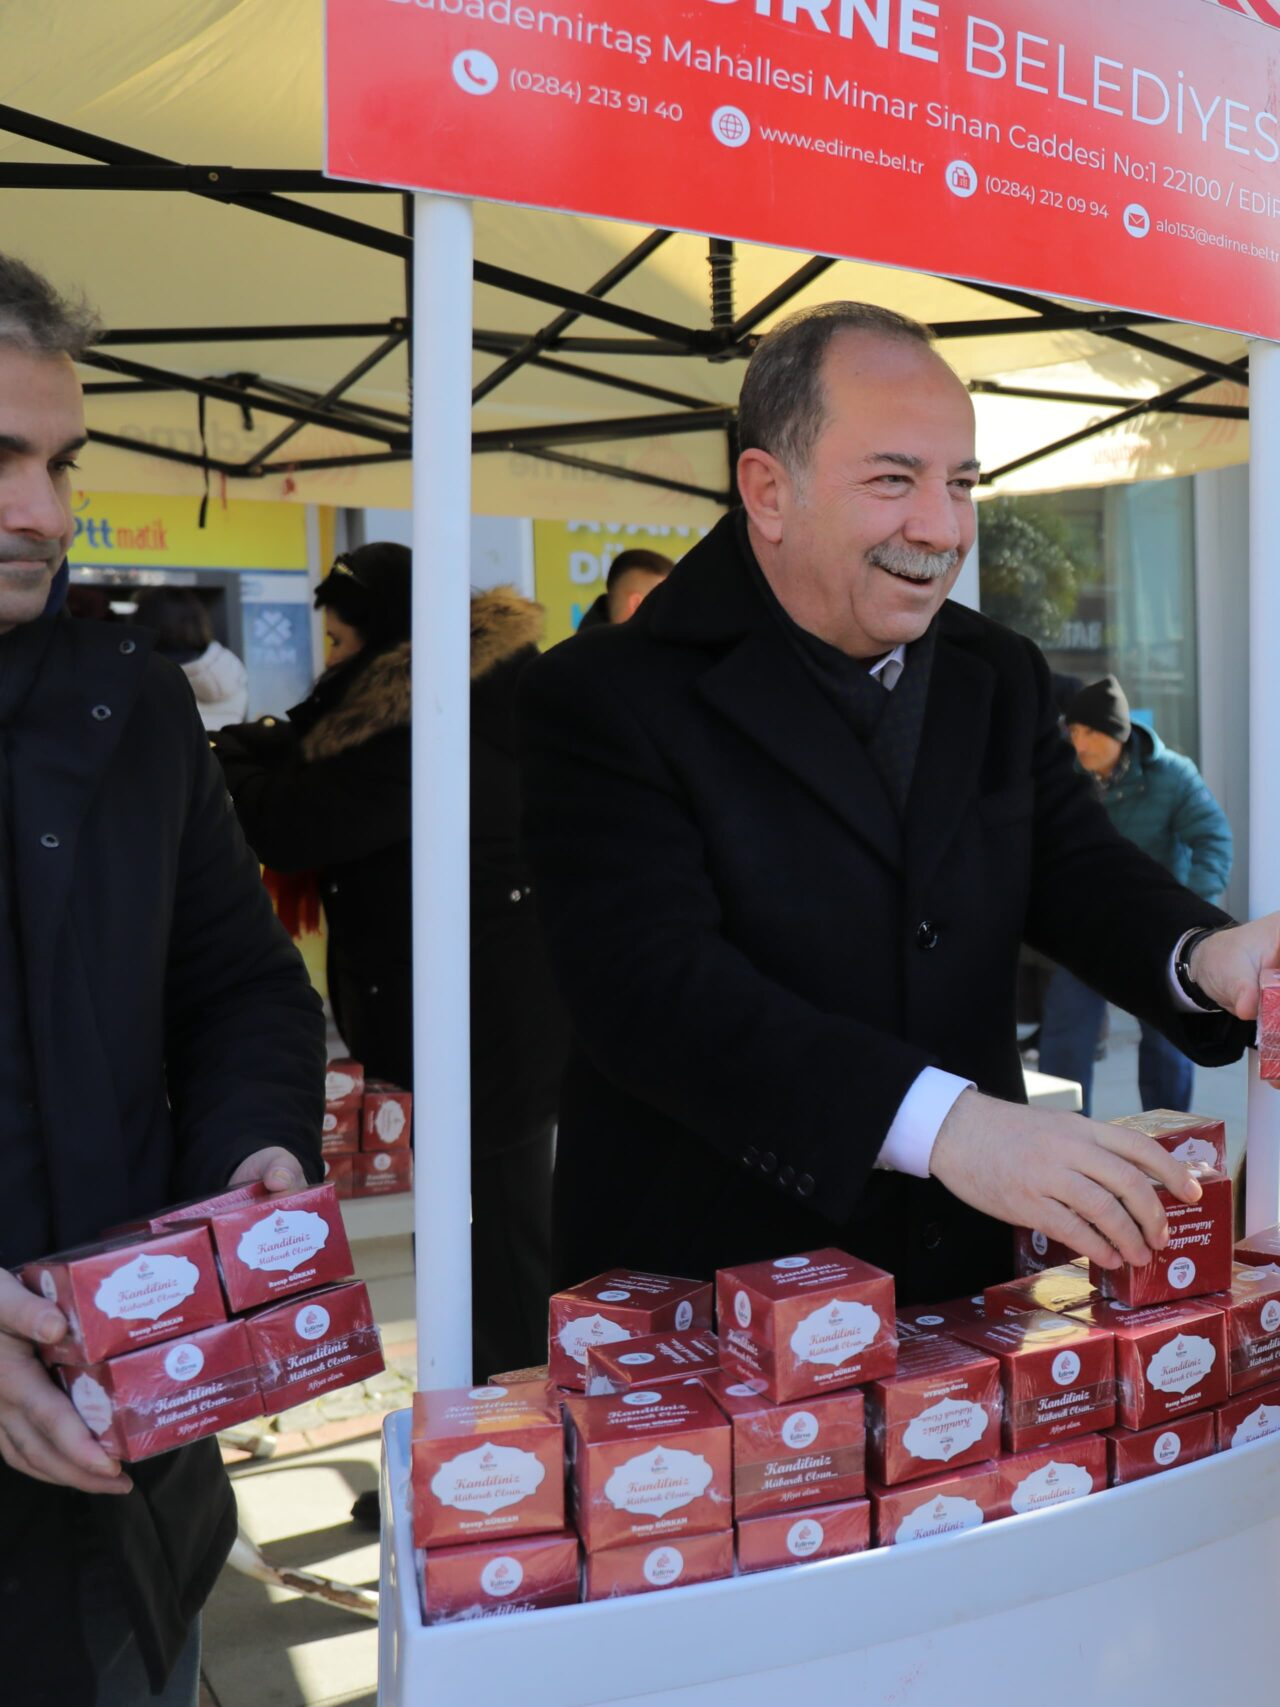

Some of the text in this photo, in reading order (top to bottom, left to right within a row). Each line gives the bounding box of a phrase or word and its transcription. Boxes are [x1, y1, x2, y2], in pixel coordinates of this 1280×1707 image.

[509, 68, 683, 122] (0284) 213 91 40
[663, 35, 813, 96] Mahallesi
[823, 74, 918, 121] Mimar
[926, 102, 1000, 143] Sinan
[1008, 124, 1105, 170] Caddesi
[1113, 151, 1157, 184] No:1
[1163, 166, 1221, 201] 22100
[759, 125, 925, 175] www.edirne.bel.tr
[985, 175, 1110, 218] (0284) 212 09 94
[1156, 217, 1280, 262] alo153@edirne.bel.tr
[257, 1233, 311, 1255] Kandiliniz
[809, 1327, 861, 1346] Kandiliniz
[287, 1340, 349, 1370] Kandiliniz
[1160, 1358, 1201, 1376] Kandiliniz
[154, 1382, 225, 1414] Kandiliniz
[1038, 1390, 1090, 1411] Kandiliniz
[1036, 1406, 1068, 1424] Mübarek
[764, 1455, 833, 1477] Kandiliniz
[761, 1475, 803, 1490] Mübarek
[1027, 1487, 1076, 1505] Kandiliniz
[912, 1521, 965, 1541] Kandiliniz
